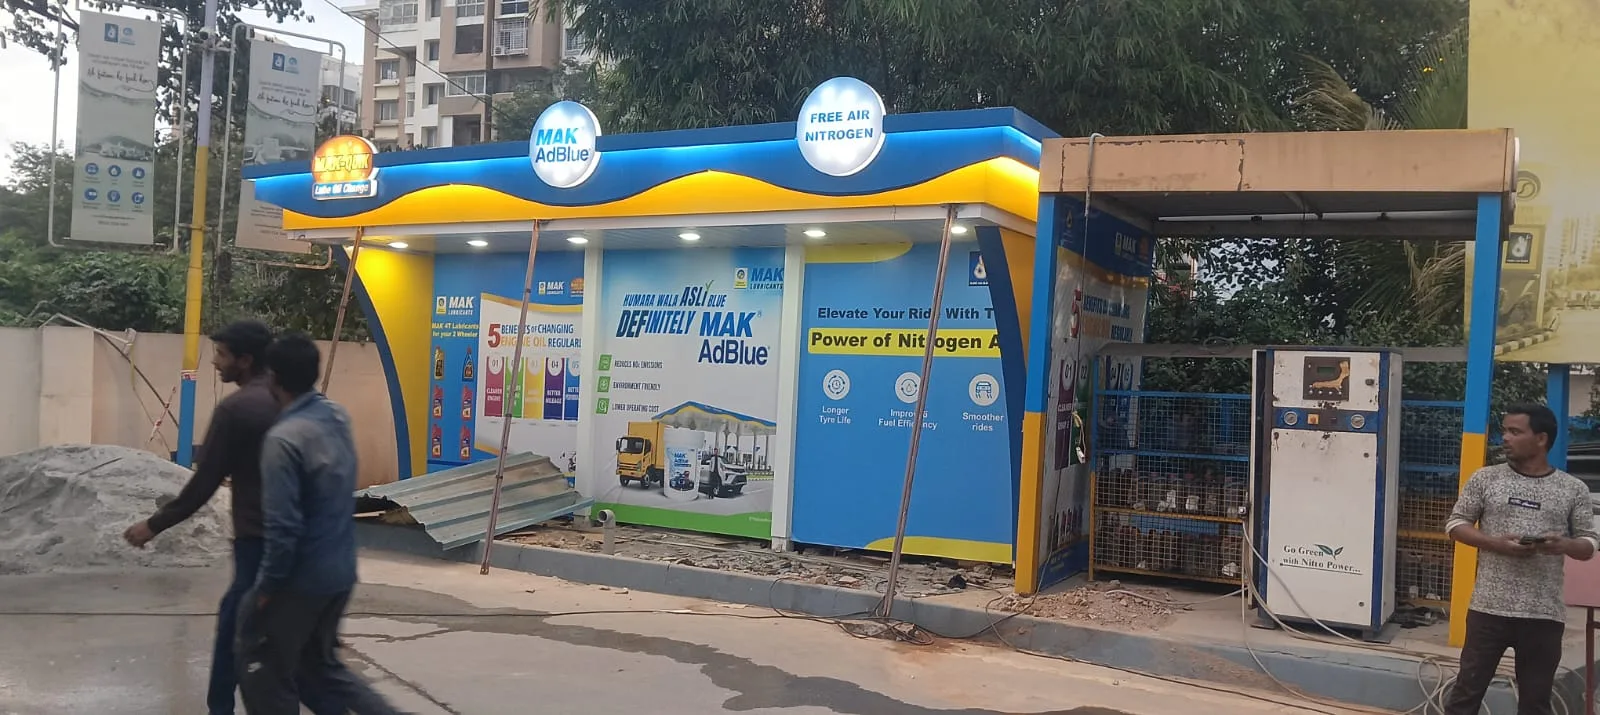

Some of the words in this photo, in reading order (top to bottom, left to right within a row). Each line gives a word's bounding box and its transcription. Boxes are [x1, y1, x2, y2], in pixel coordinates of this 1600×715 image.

[811, 112, 843, 123] FREE
[847, 110, 870, 121] AIR
[536, 128, 578, 146] MAK
[805, 128, 874, 141] NITROGEN
[535, 146, 589, 163] AdBlue
[343, 182, 369, 194] Change
[751, 267, 784, 282] MAK
[547, 281, 564, 290] MAK
[449, 296, 475, 309] MAK
[623, 294, 655, 307] HUMARA
[656, 295, 679, 307] WALA
[707, 294, 727, 308] BLUE
[818, 308, 868, 319] Elevate
[873, 308, 905, 319] Your
[909, 308, 937, 319] Rid
[945, 308, 979, 320] With
[616, 310, 696, 338] DEFINITELY
[699, 311, 756, 338] MAK
[487, 323, 501, 348] 5
[501, 324, 531, 335] BENES
[537, 323, 574, 334] CHANGING
[500, 334, 531, 347] ENGE
[534, 335, 547, 348] OIL
[812, 332, 868, 347] Power
[873, 333, 892, 348] of
[898, 333, 982, 352] Nitogen
[697, 339, 769, 366] AdBlue
[491, 359, 499, 368] 01
[551, 360, 559, 369] 04
[1064, 363, 1072, 379] 01
[822, 405, 850, 416] Longer
[890, 408, 928, 419] Impro
[962, 412, 1005, 422] Smoother
[819, 415, 836, 424] Tyre
[837, 416, 851, 424] Life
[878, 418, 896, 426] Fuel
[897, 419, 938, 431] Effincy
[972, 422, 993, 432] rides
[1283, 545, 1296, 554] Go
[1298, 546, 1324, 557] Green
[1283, 557, 1299, 565] with
[1301, 558, 1324, 568] Nitro
